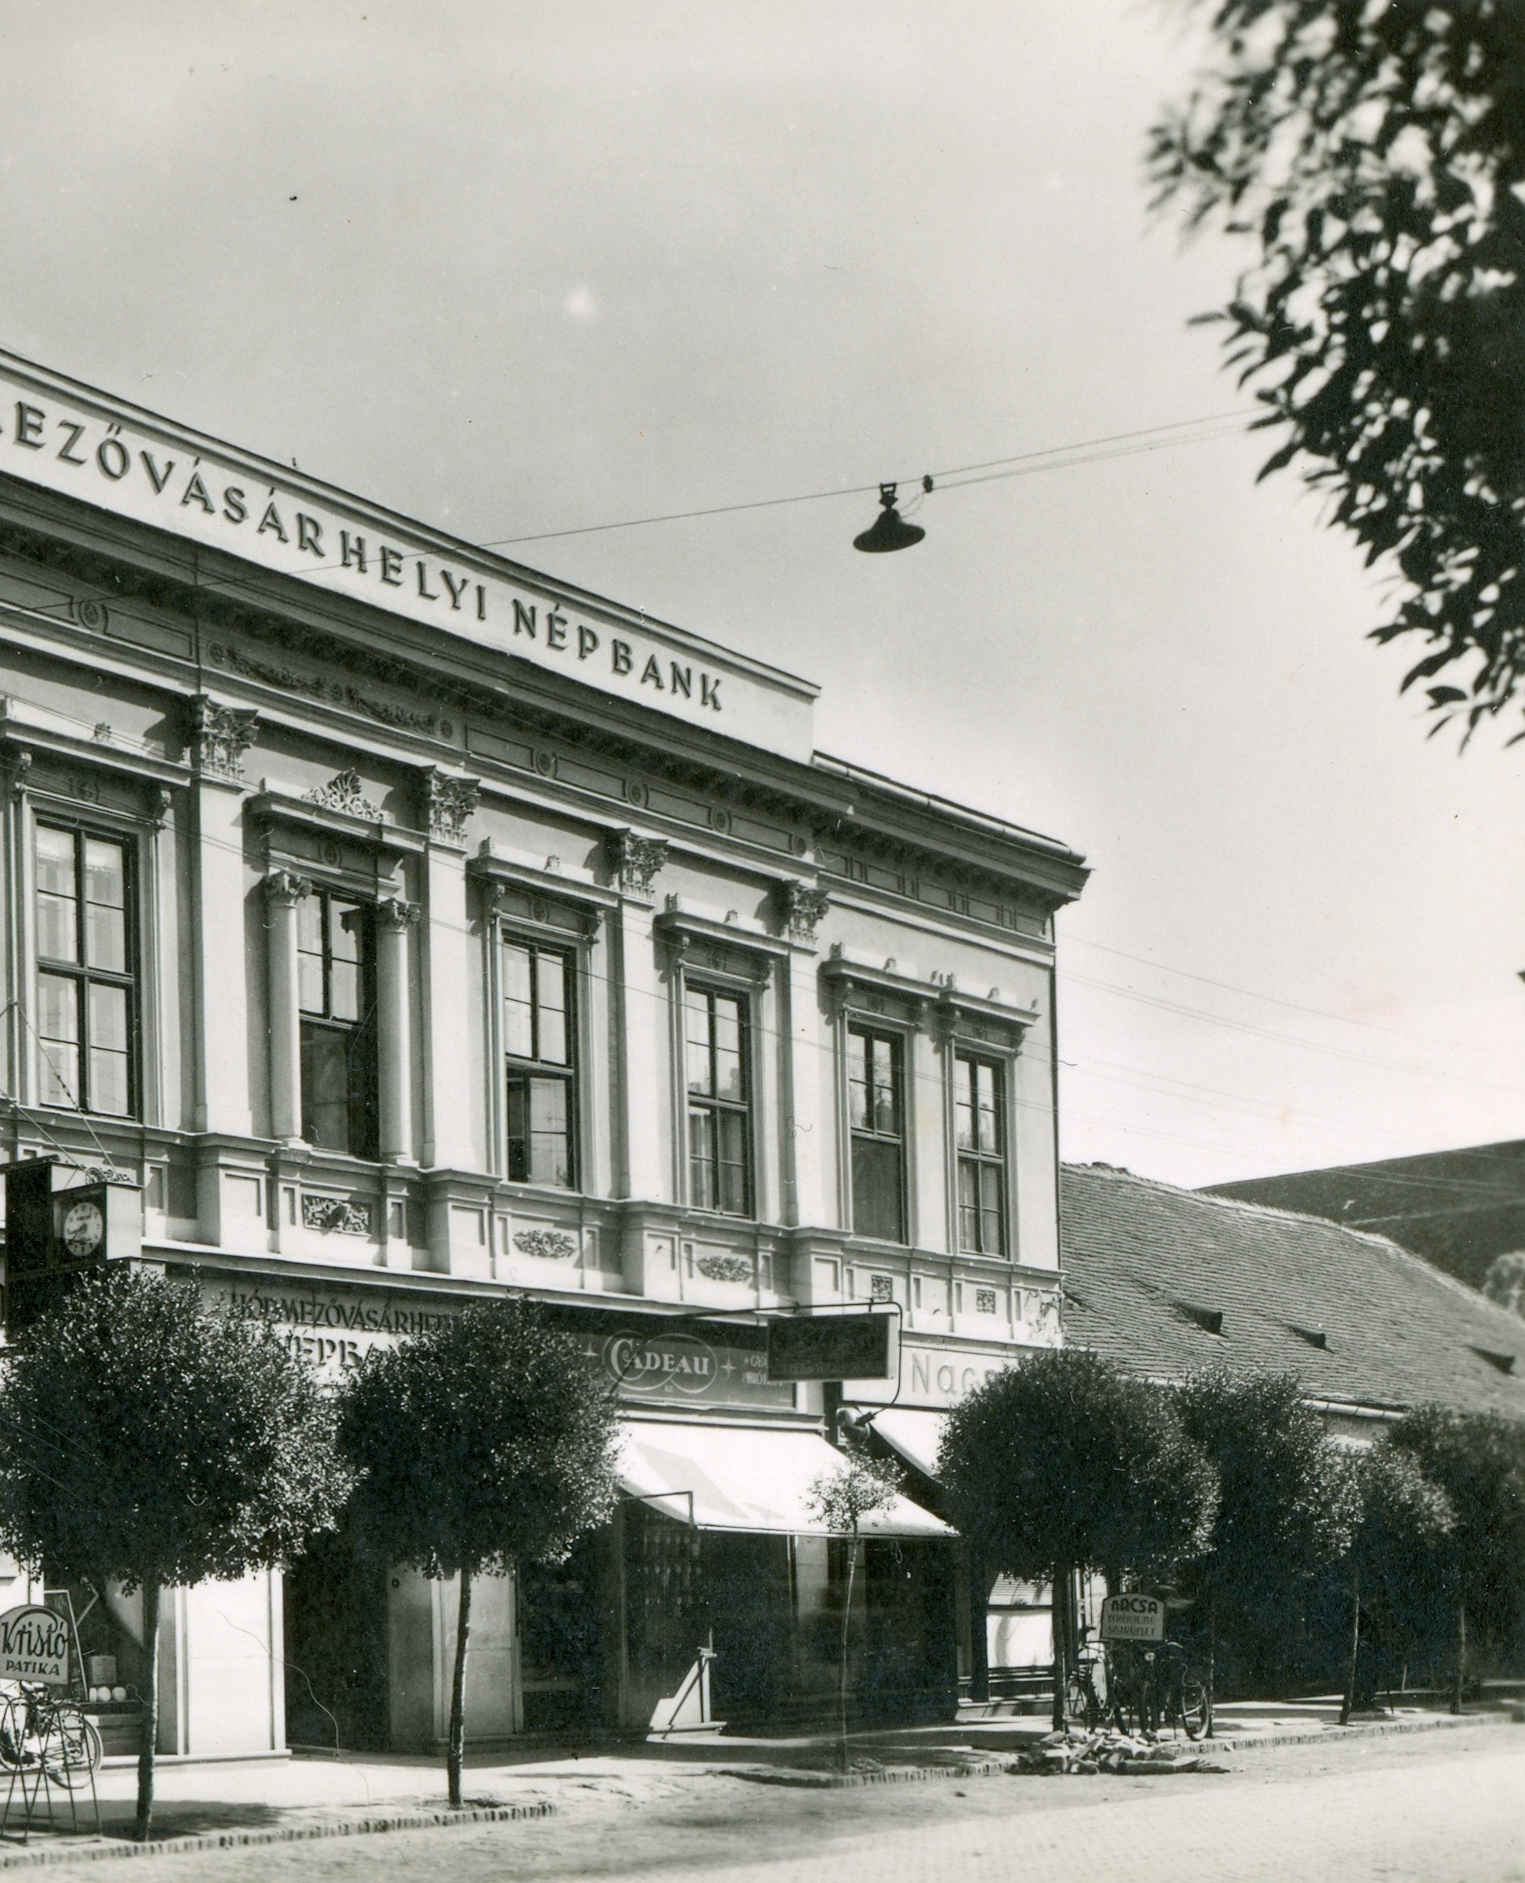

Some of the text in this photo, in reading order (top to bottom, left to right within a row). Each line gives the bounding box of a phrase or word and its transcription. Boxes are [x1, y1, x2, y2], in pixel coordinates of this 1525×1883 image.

[512, 601, 724, 711] NÉPBANK
[1, 1609, 69, 1660] Kristó
[5, 1660, 61, 1677] PATIKA
